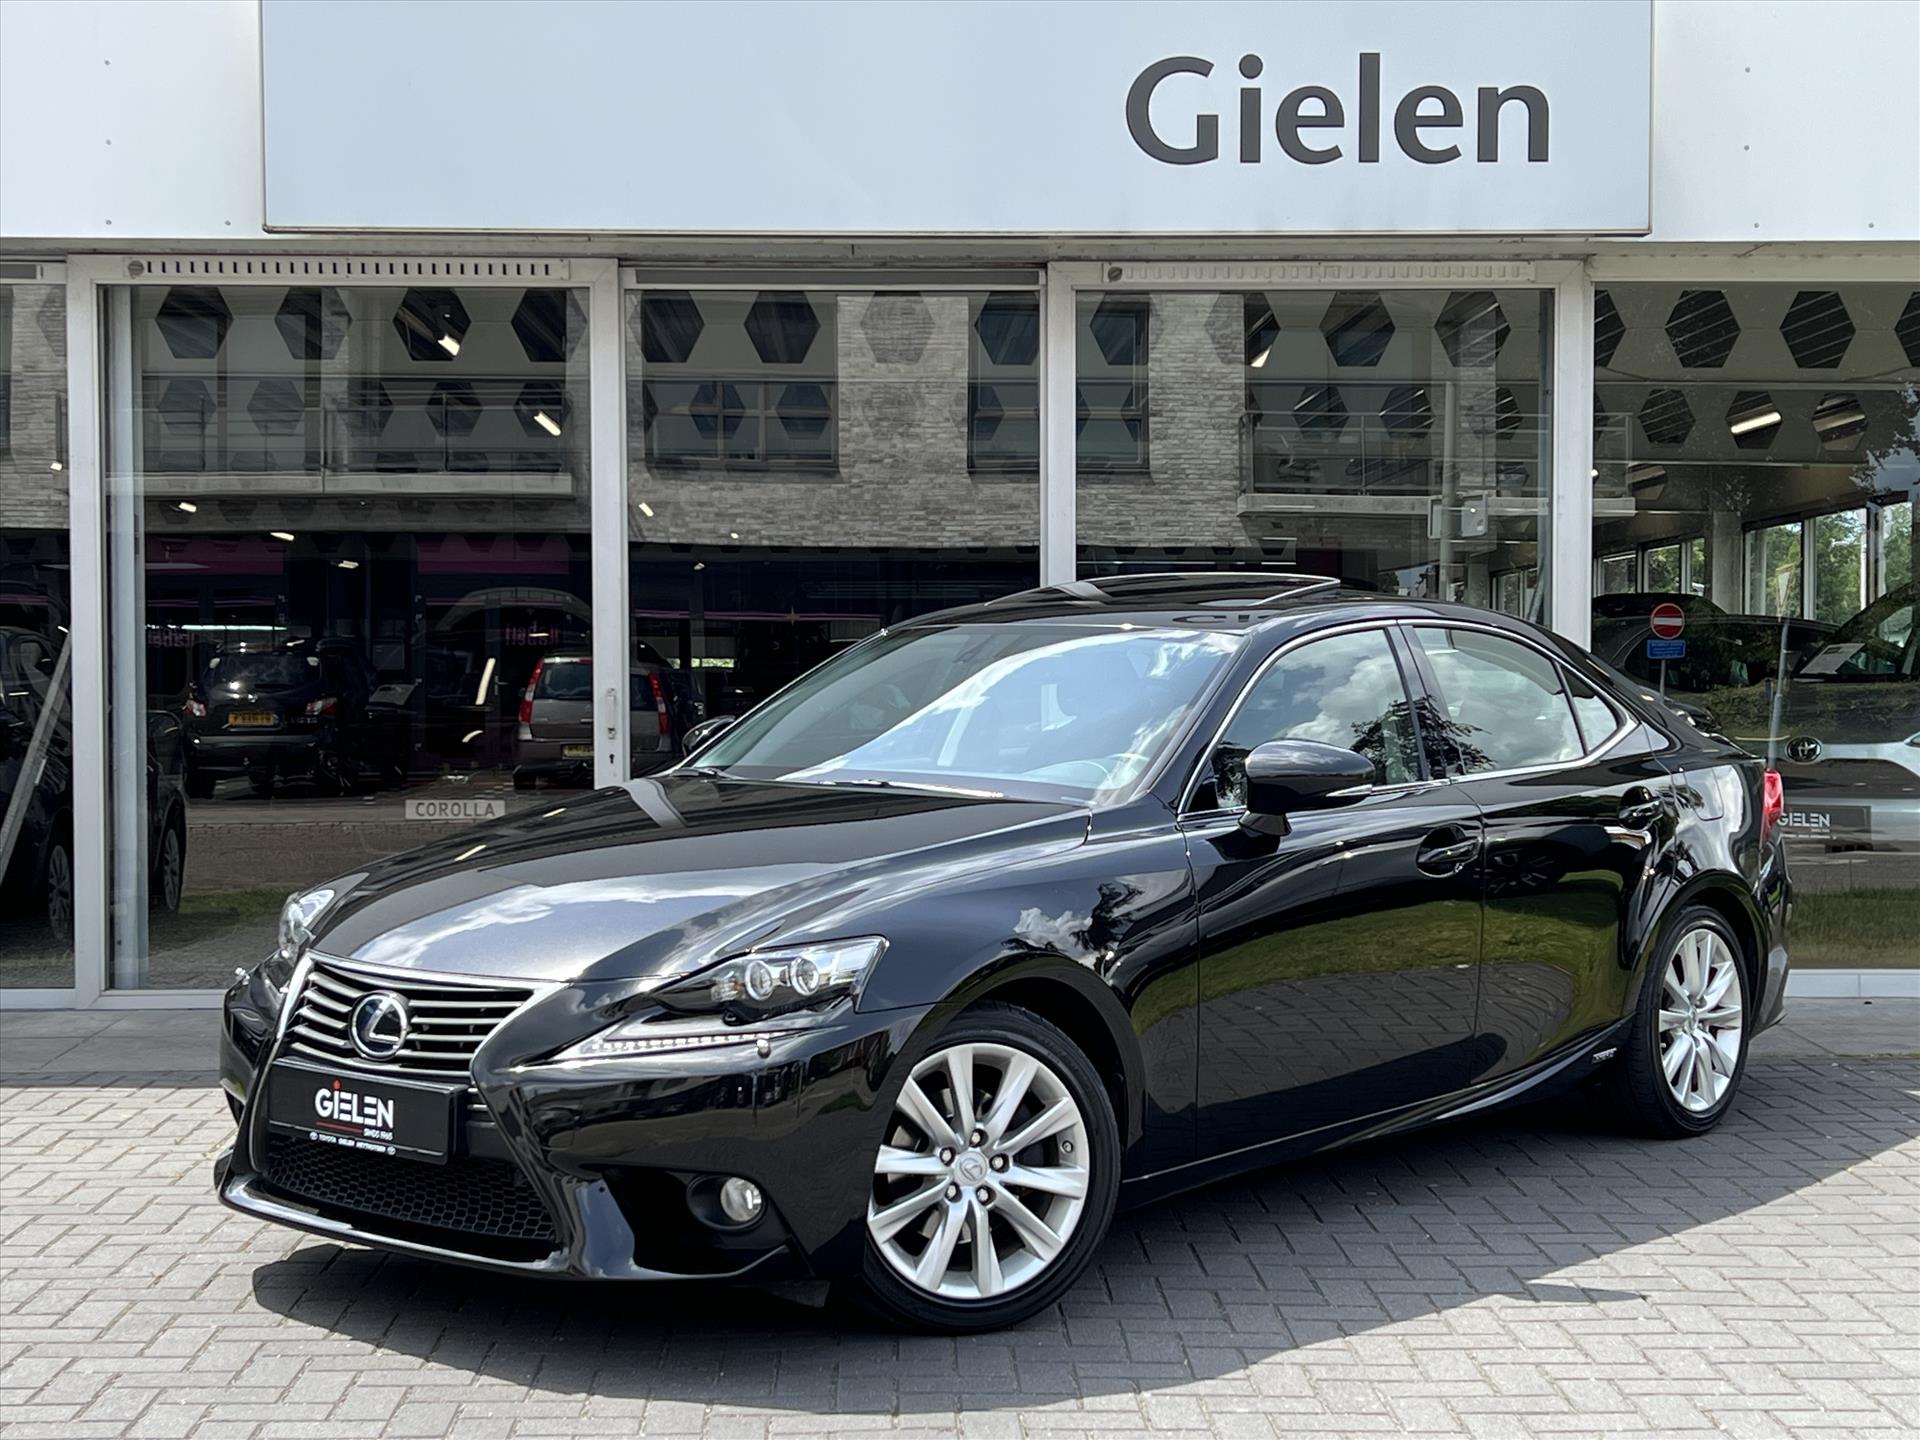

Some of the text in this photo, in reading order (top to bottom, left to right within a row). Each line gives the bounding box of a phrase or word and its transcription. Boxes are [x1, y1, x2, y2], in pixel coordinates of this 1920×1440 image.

[1126, 53, 1550, 165] Gielen
[416, 802, 495, 817] COROLLA
[1777, 812, 1831, 827] GIELEN
[314, 1080, 394, 1129] GIELEN
